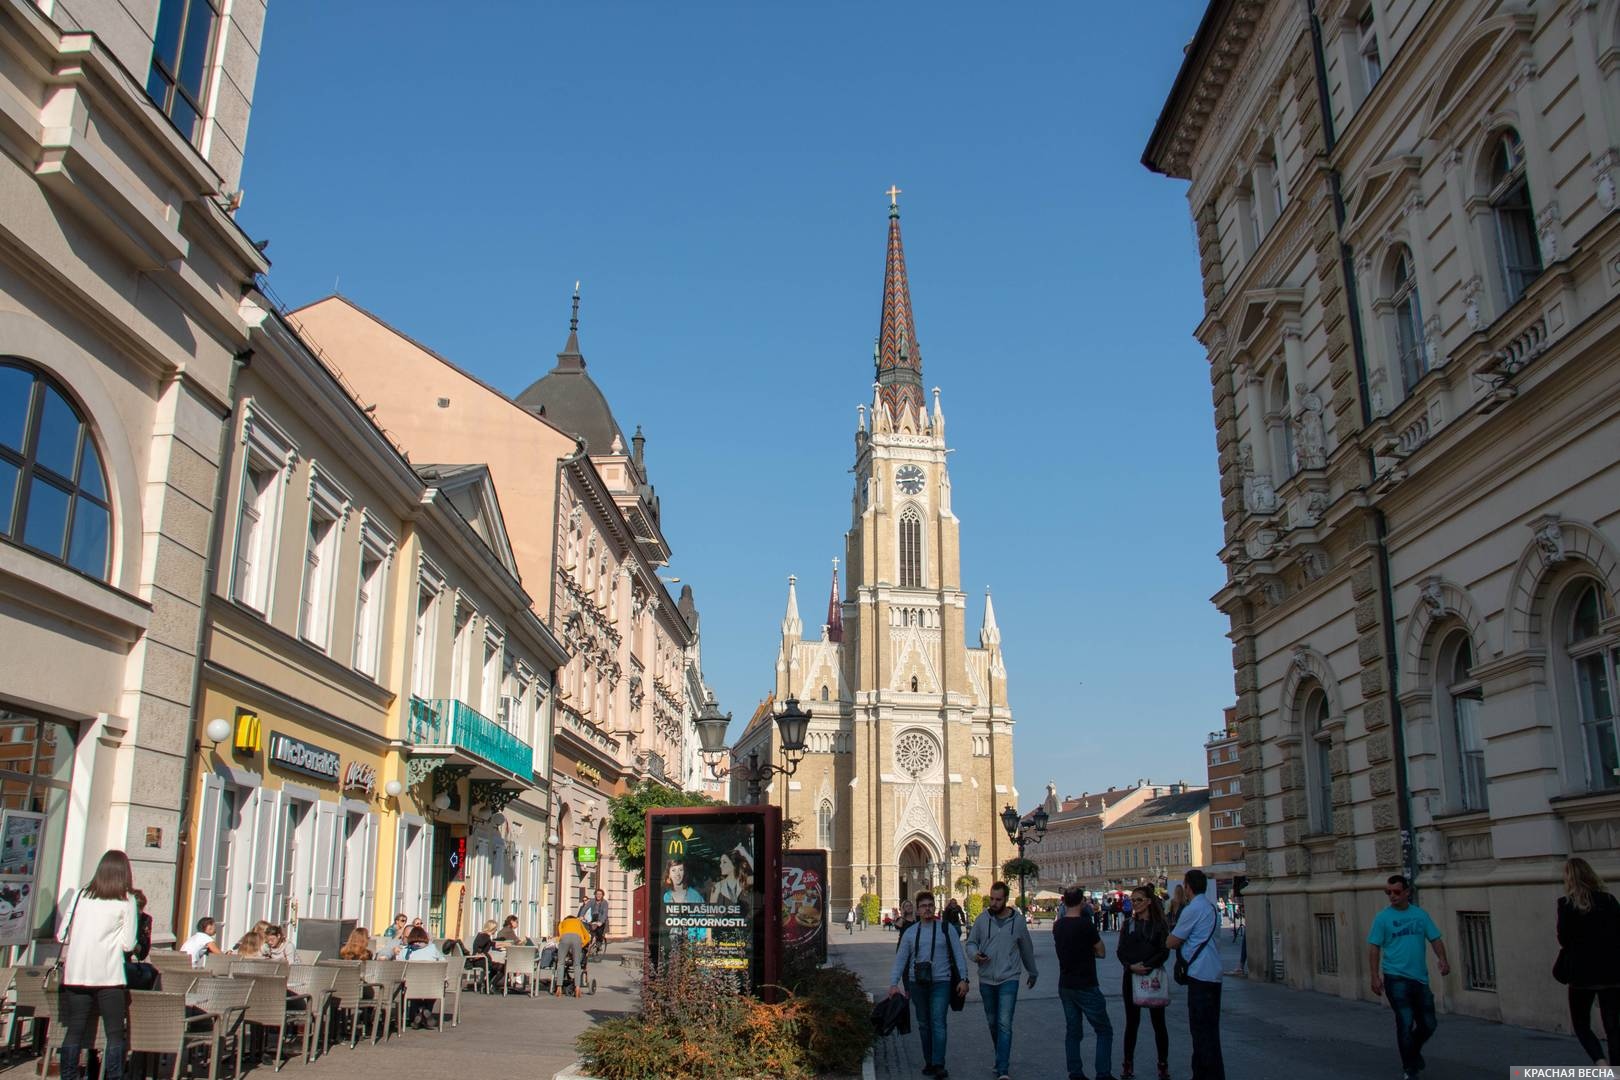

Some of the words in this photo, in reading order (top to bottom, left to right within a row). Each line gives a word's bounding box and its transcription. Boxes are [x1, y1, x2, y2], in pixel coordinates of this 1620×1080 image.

[276, 737, 340, 777] McDonald's
[666, 905, 680, 914] NE
[681, 904, 726, 914] PLAŠIMO
[728, 905, 741, 914] SE
[665, 918, 747, 927] ODGOVORNOSTI.
